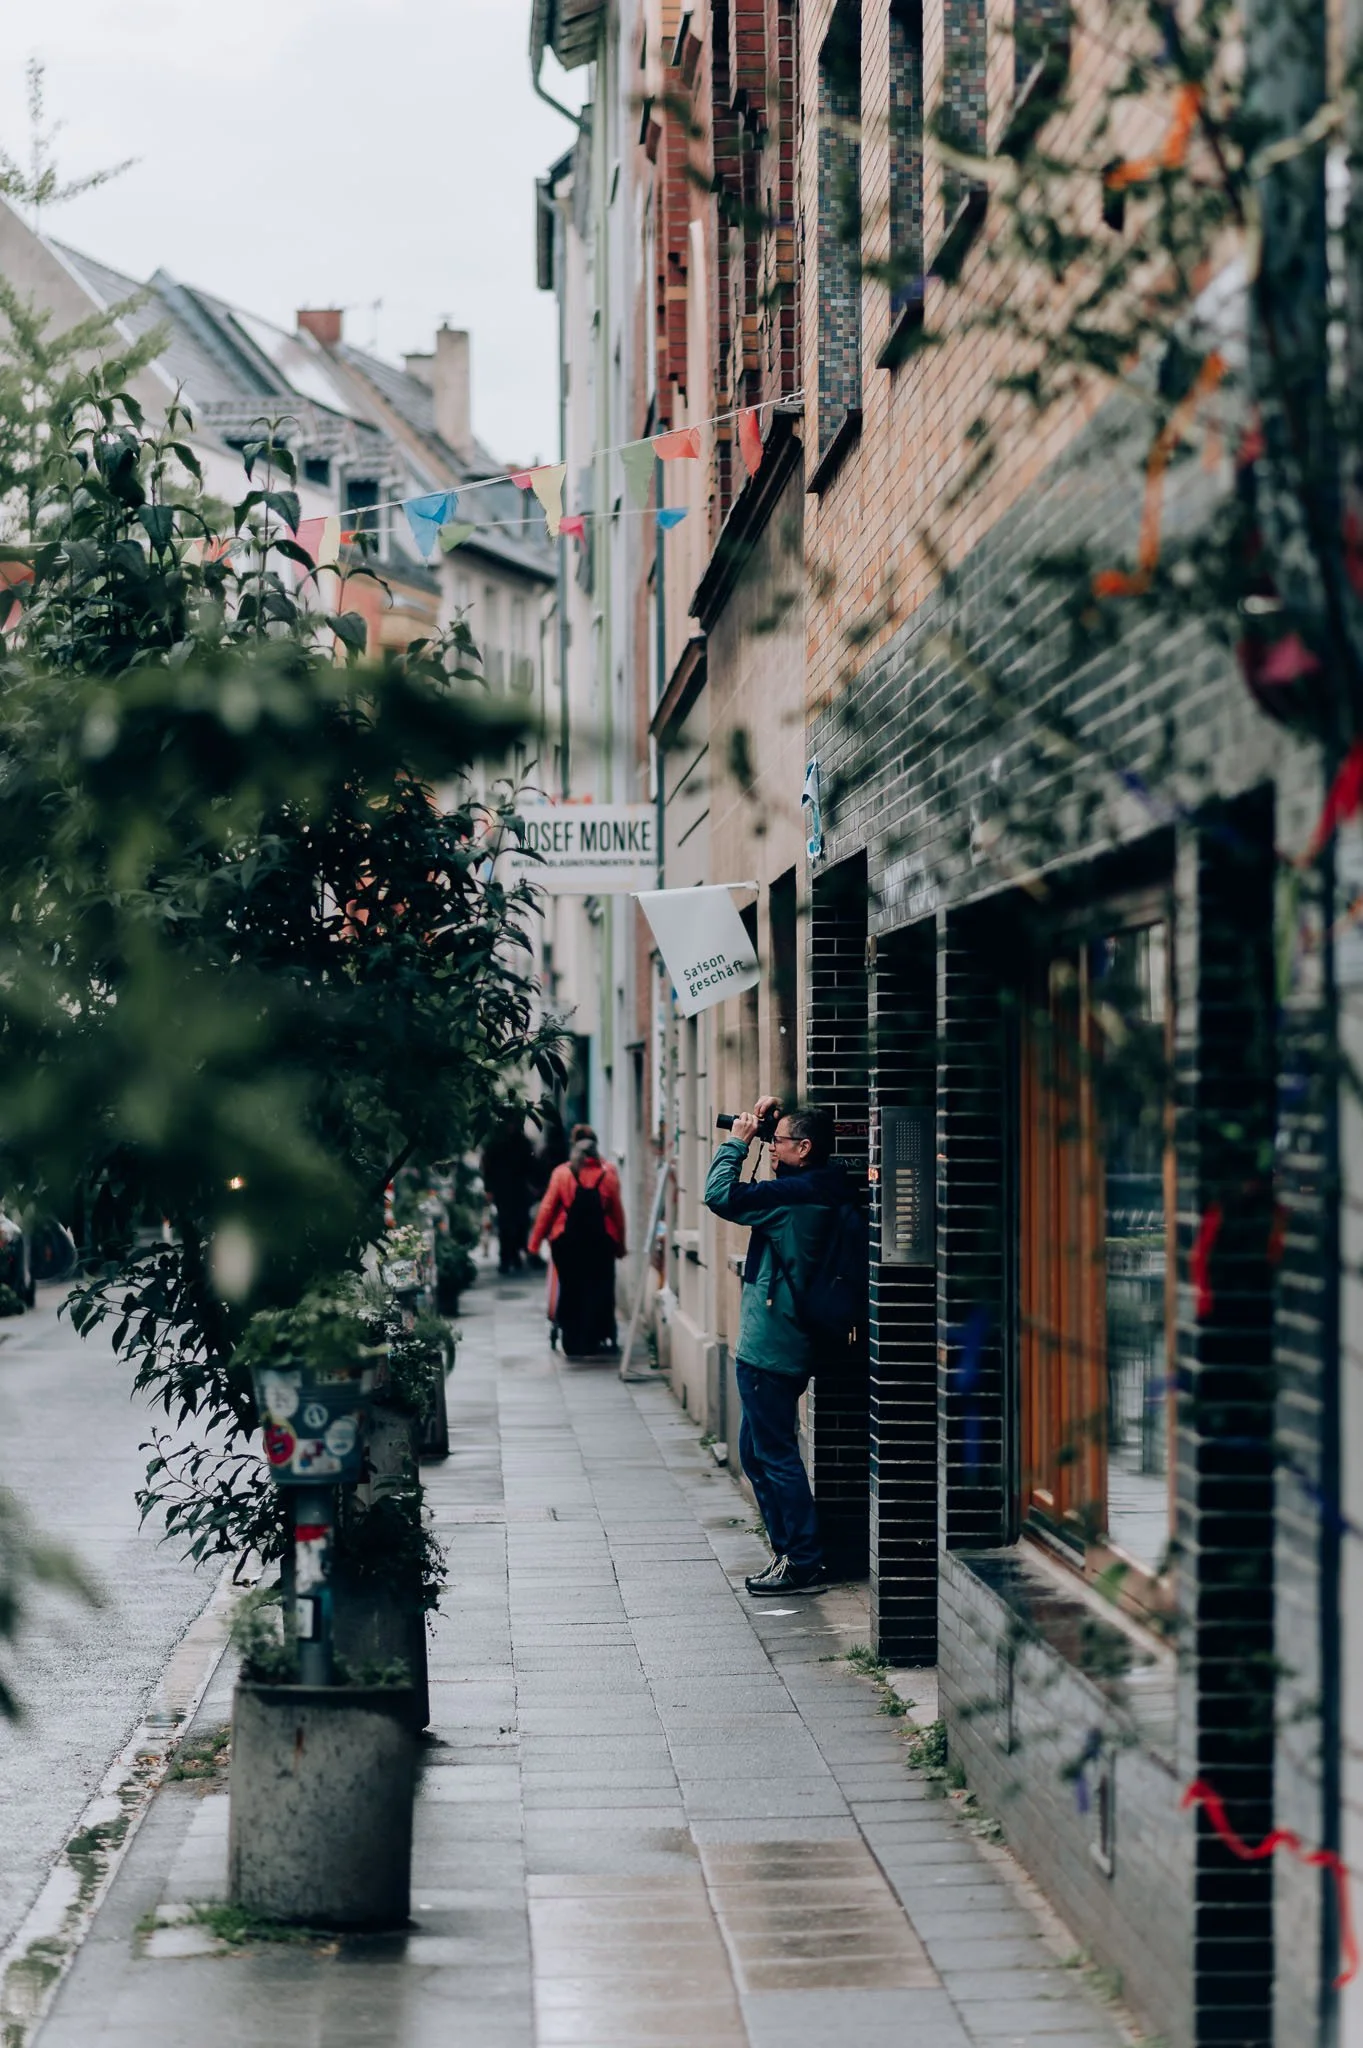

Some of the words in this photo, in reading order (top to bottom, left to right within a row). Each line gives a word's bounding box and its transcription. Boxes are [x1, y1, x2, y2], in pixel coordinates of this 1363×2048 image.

[515, 821, 574, 852] OSEF
[580, 821, 651, 852] MONKE
[683, 954, 726, 981] Saison
[689, 959, 745, 997] geschäft
